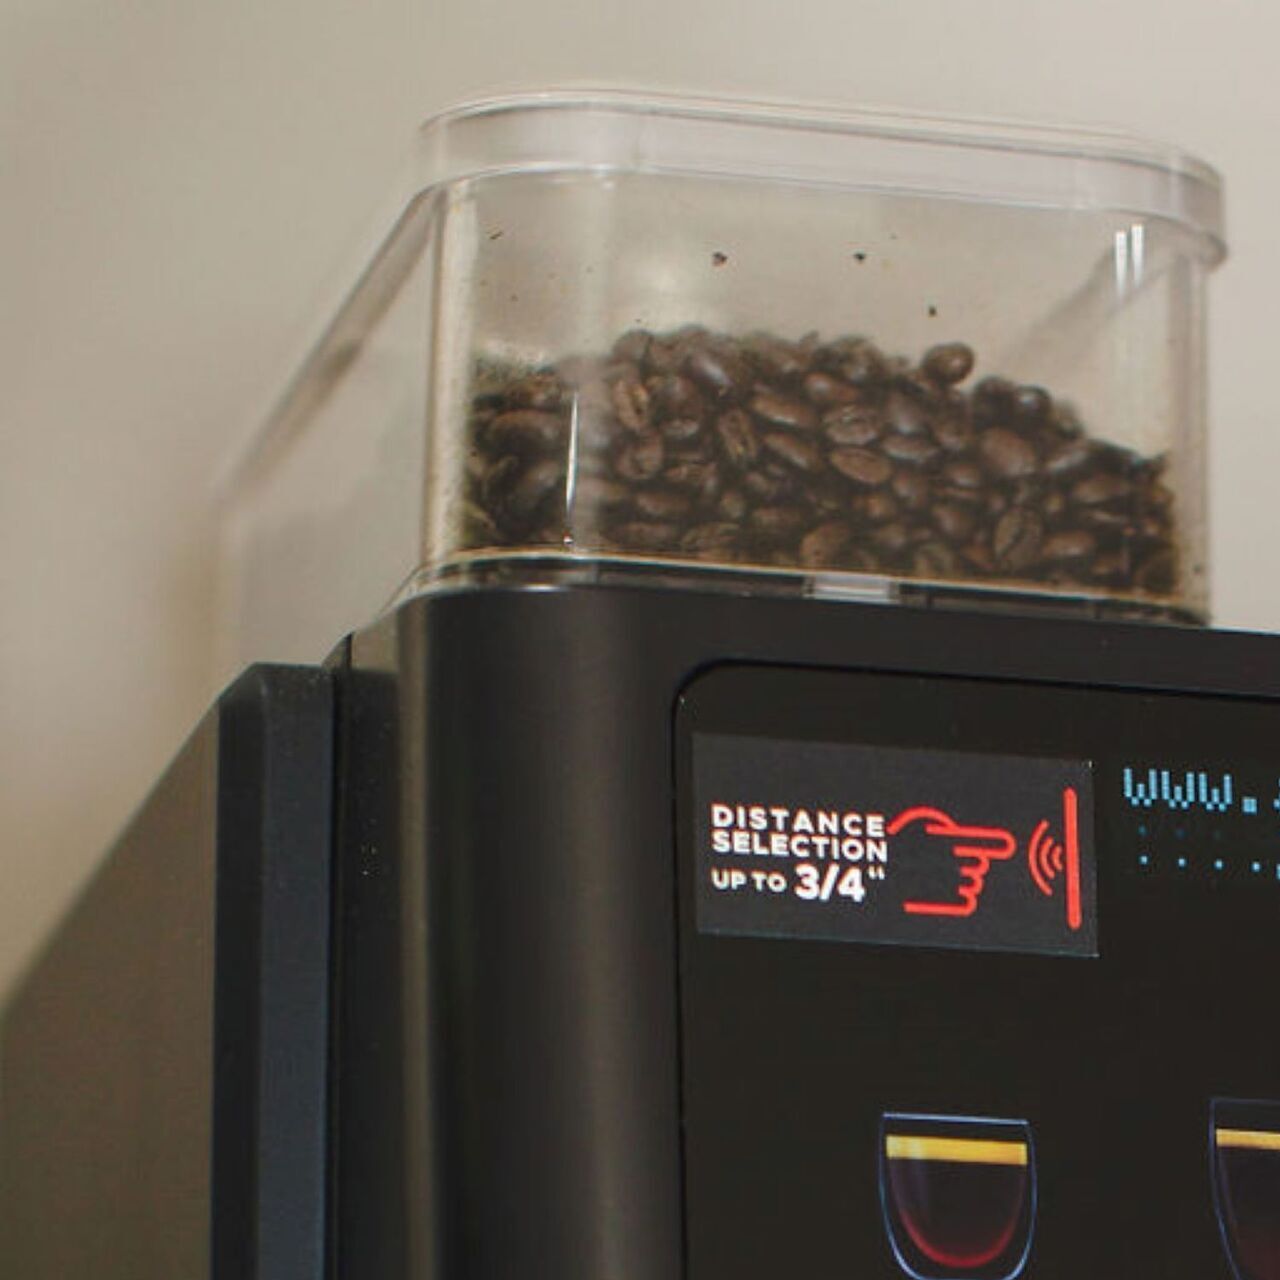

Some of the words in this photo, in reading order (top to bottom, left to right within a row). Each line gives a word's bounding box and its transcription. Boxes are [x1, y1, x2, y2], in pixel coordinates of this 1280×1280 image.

[711, 803, 886, 838] DISTANCE
[711, 829, 888, 862] SELECTION
[710, 867, 747, 890] UP
[751, 870, 787, 892] TO
